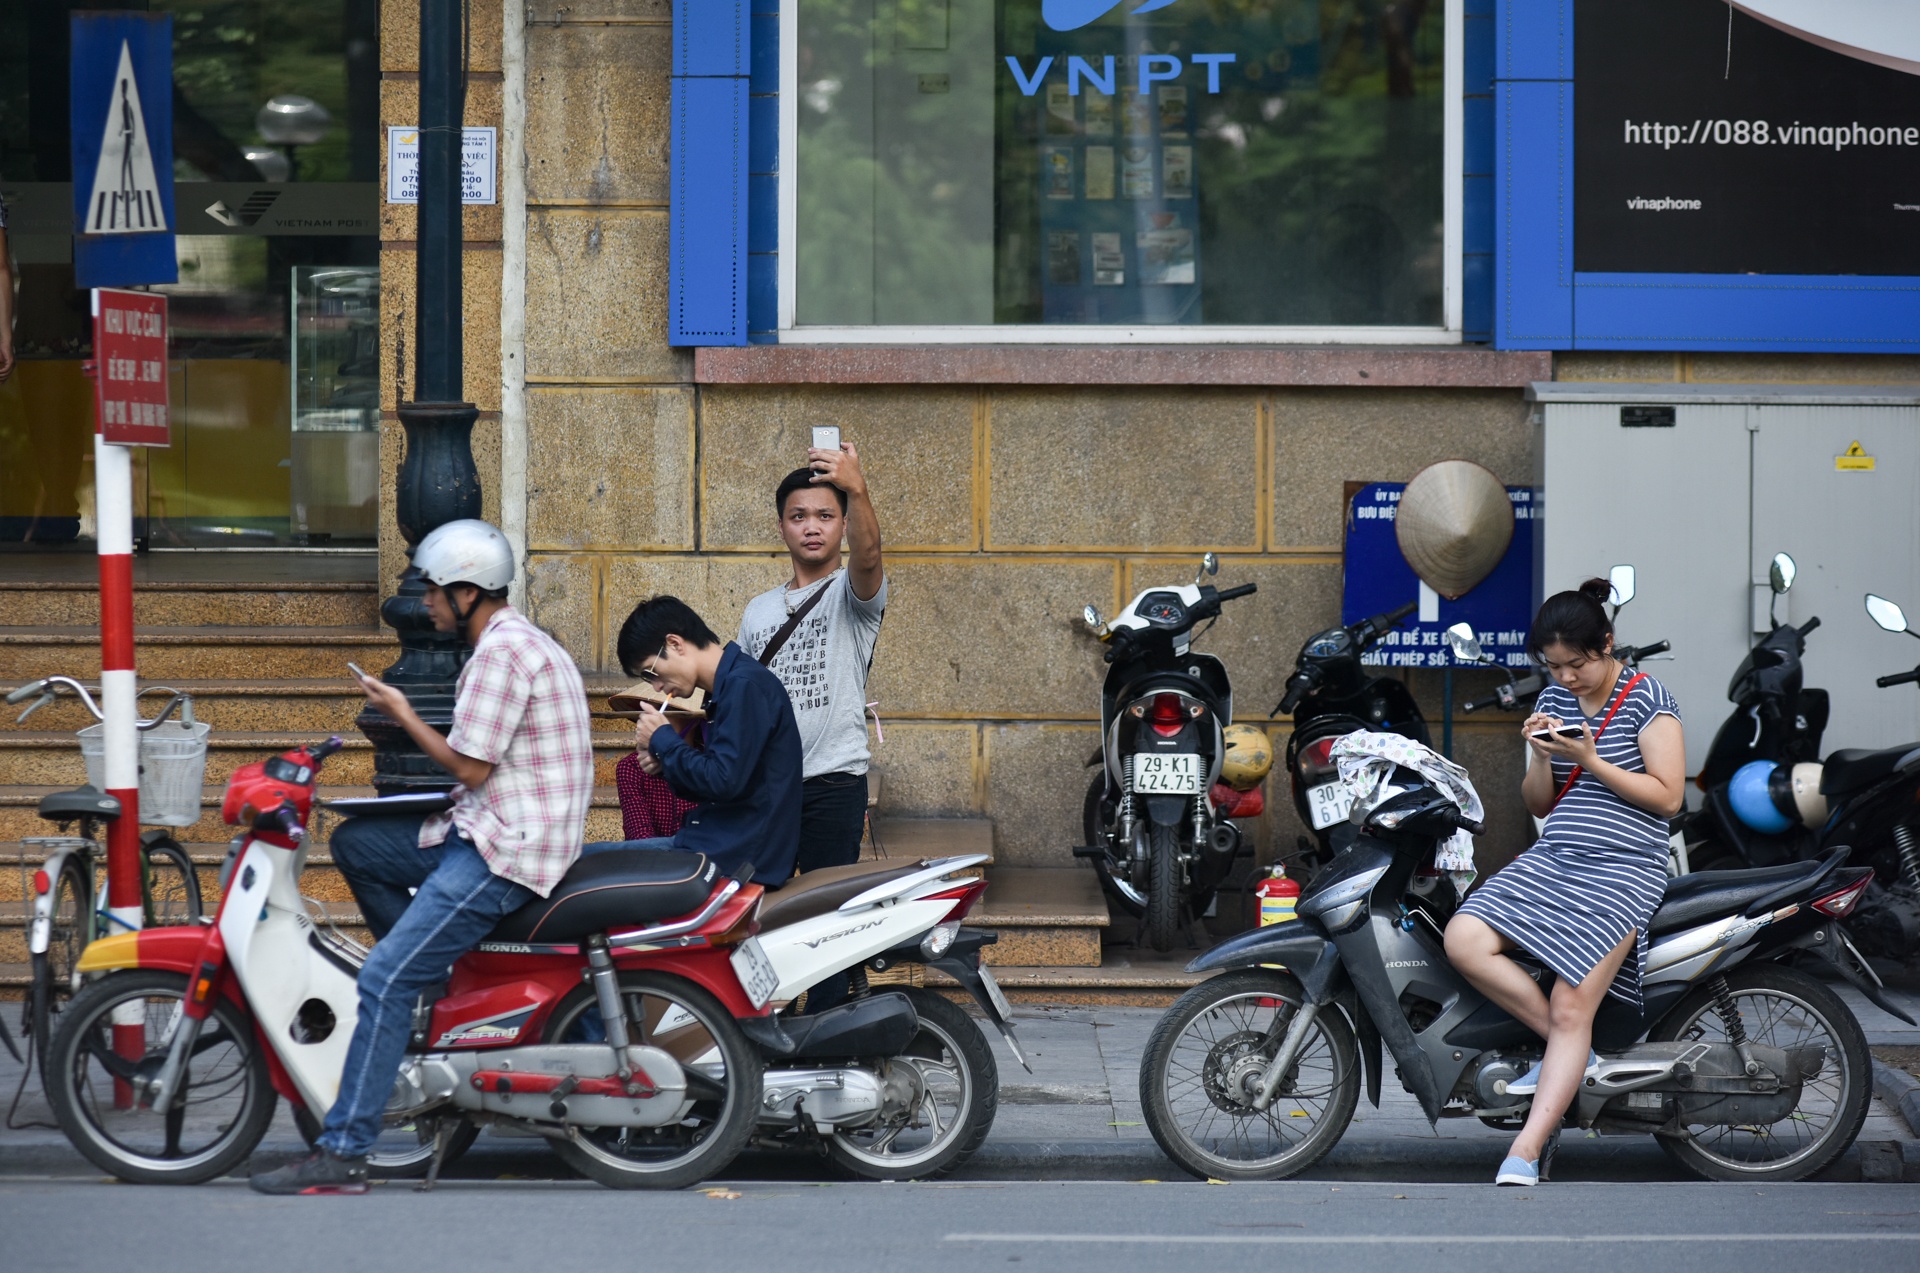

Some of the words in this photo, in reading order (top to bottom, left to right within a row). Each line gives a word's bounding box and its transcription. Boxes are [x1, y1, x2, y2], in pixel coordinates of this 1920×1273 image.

[1005, 53, 1236, 96] VNPT
[1624, 119, 1920, 151] http://088.vinaphone
[466, 152, 487, 160] VIỆC
[1627, 196, 1702, 211] vinaphone
[275, 219, 332, 228] VIETNAM
[337, 219, 369, 228] POST
[1375, 488, 1388, 501] ỦY
[1388, 491, 1403, 501] BA
[1358, 506, 1377, 519] BƯU
[1378, 504, 1397, 521] ĐIỆ
[1515, 505, 1529, 519] HÀ
[1402, 627, 1419, 646] ĐỂ
[1422, 632, 1439, 646] XE
[1478, 632, 1495, 646] XE
[1497, 629, 1526, 646] MÁY
[1360, 648, 1390, 666] GIẤY
[1391, 649, 1425, 666] PHÉP
[1427, 648, 1449, 666] SỐ:
[1144, 757, 1188, 772] 29-K1
[1139, 775, 1195, 790] 424.75
[793, 916, 888, 948] VISION
[480, 944, 531, 953] HONDA
[1385, 960, 1429, 968] HONDA
